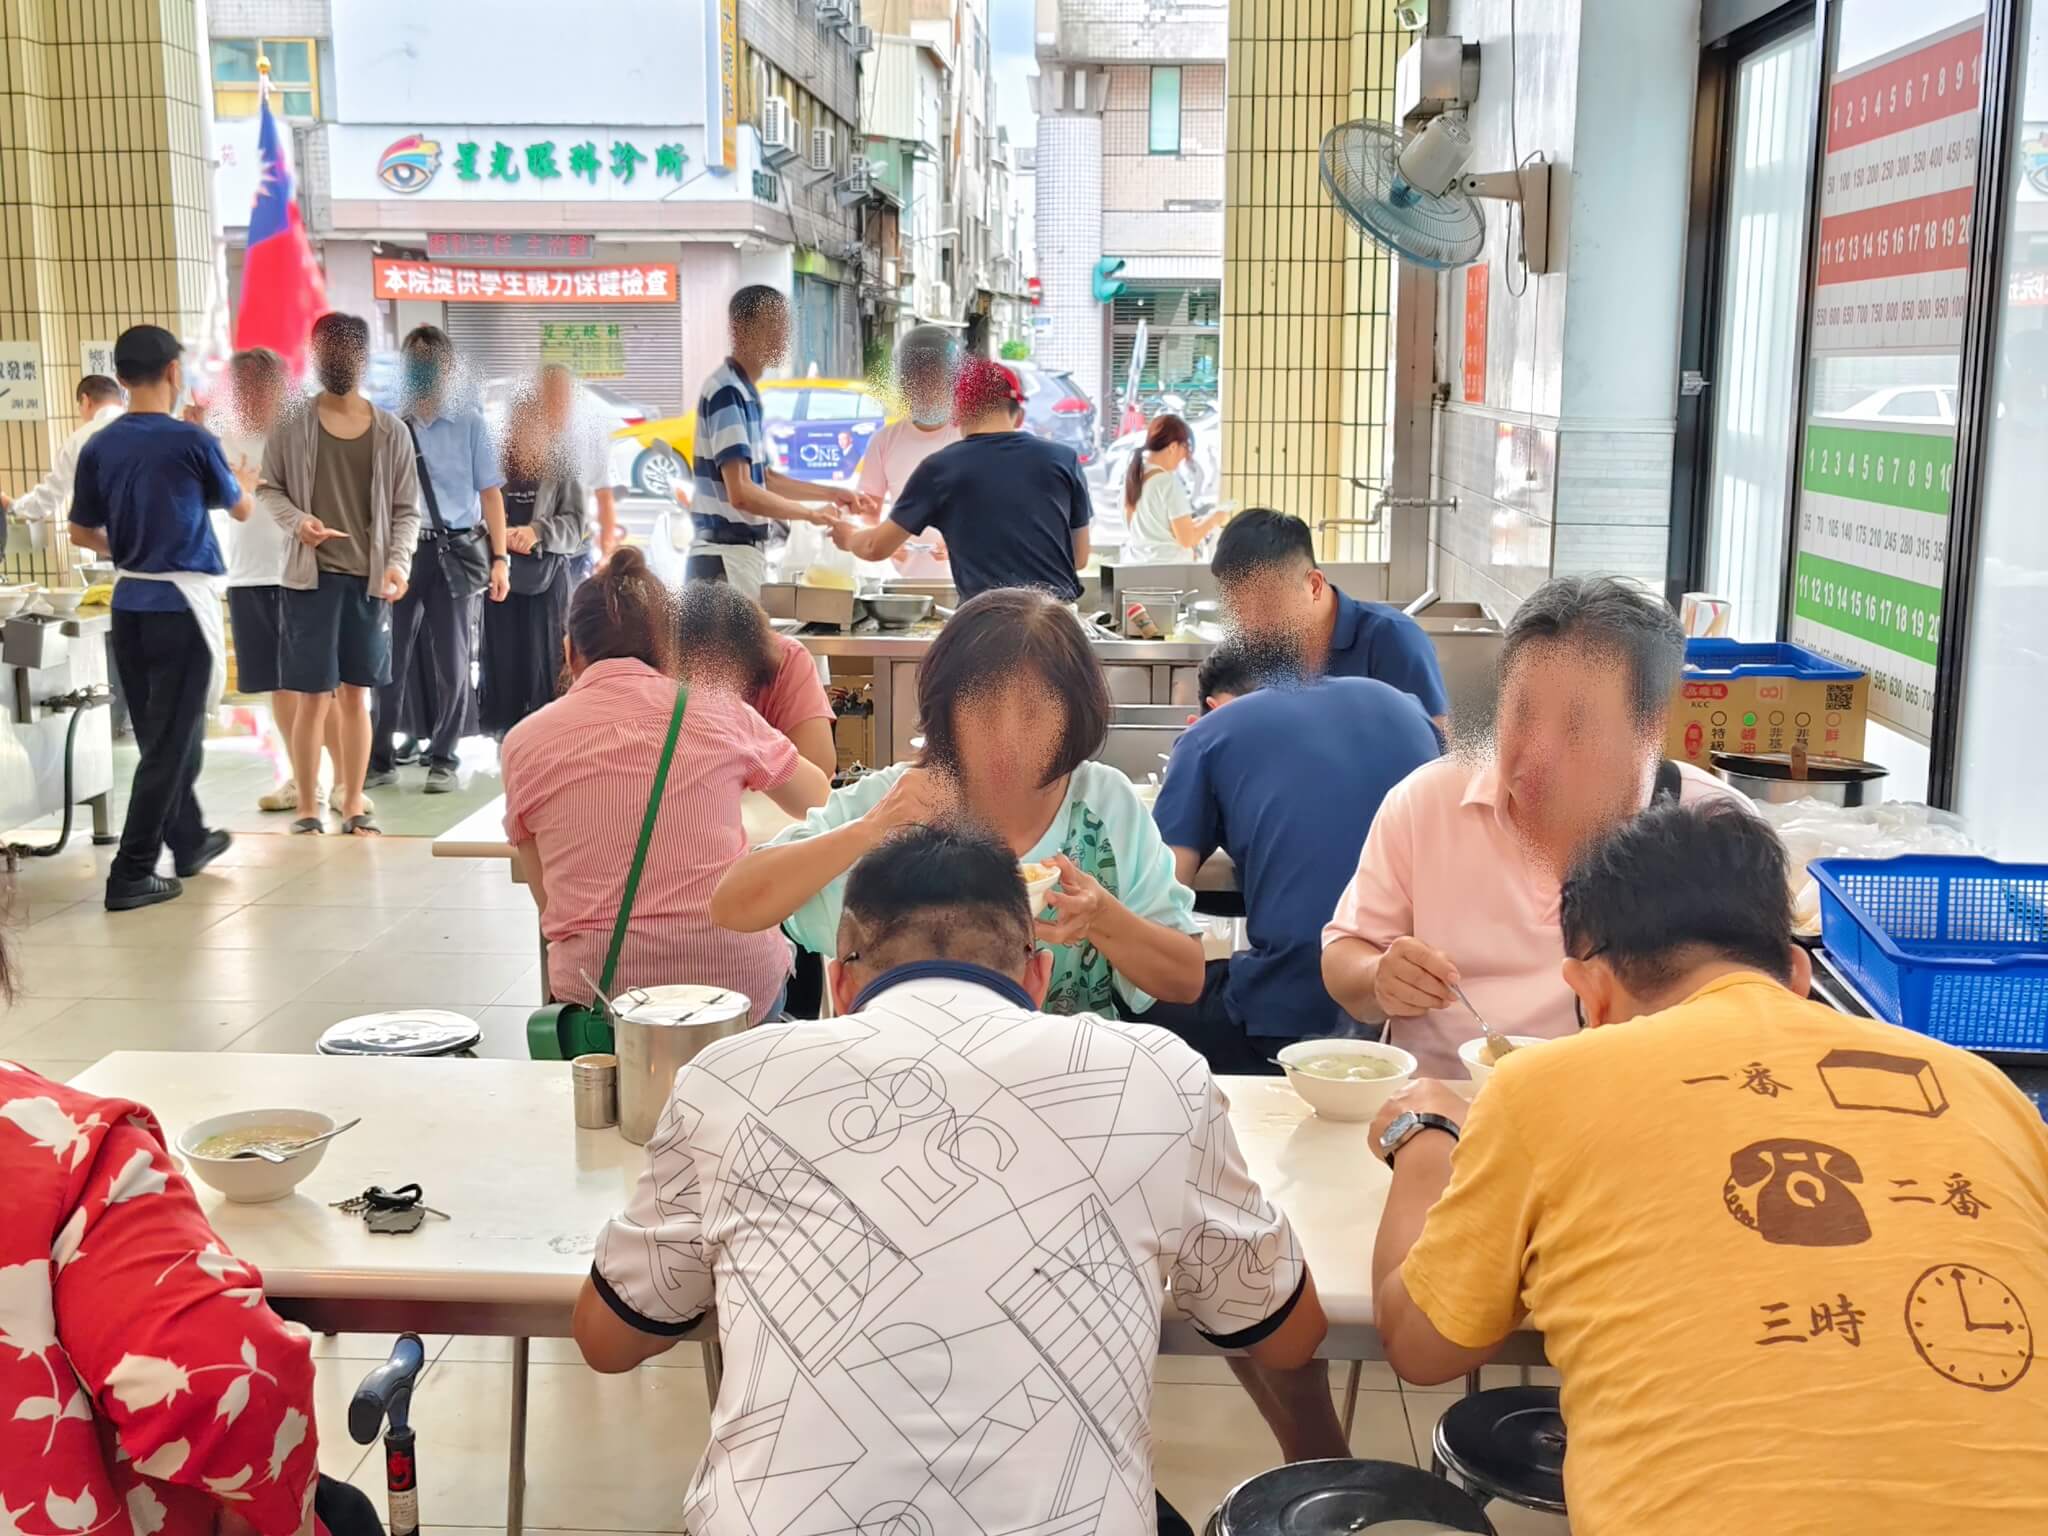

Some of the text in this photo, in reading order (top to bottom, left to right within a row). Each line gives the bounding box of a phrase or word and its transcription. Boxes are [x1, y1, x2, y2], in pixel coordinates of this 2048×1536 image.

[1834, 54, 1980, 132] 1 2 3 4 5 6 7 8 9 1
[454, 140, 690, 184] 星光眼科診所
[1853, 167, 1865, 187] 150
[1866, 163, 1879, 184] 200
[1881, 160, 1894, 181] 250
[1896, 156, 1910, 177] 300
[1912, 151, 1926, 173] 350
[1929, 146, 1943, 168] 400
[1946, 141, 1961, 163] 450
[1822, 240, 1831, 266] 11
[1834, 238, 1845, 263] 12
[1848, 235, 1859, 262] 13
[1862, 232, 1873, 259] 14
[1877, 229, 1888, 257] 15
[1892, 227, 1904, 255] 16
[1908, 223, 1921, 252] 17
[1924, 220, 1937, 249] 18
[1941, 217, 1954, 246] 19
[384, 266, 668, 298] 本院提供學生視力保健檢查
[1871, 303, 1883, 323] 750
[1901, 300, 1915, 321] 850
[1917, 299, 1931, 319] 900
[1934, 298, 1949, 318] 950
[800, 444, 841, 462] ONE
[1810, 448, 1815, 472] 1
[1821, 449, 1828, 473] 2
[1834, 451, 1841, 476] 3
[1848, 453, 1855, 478] 4
[1862, 454, 1870, 480] 5
[1877, 456, 1884, 482] 6
[1892, 458, 1900, 485] 7
[1908, 460, 1916, 488] 8
[1925, 462, 1933, 490] 9
[1828, 518, 1839, 538] 105
[1841, 521, 1852, 541] 140
[1855, 524, 1867, 545] 175
[1869, 528, 1882, 548] 210
[1883, 531, 1897, 552] 245
[1899, 534, 1913, 556] 280
[1916, 537, 1930, 561] 315
[1800, 575, 1808, 598] 11
[1811, 577, 1821, 603] 12
[1824, 582, 1833, 607] 13
[1837, 586, 1848, 611] 14
[1851, 590, 1862, 617] 15
[1865, 594, 1876, 622] 16
[1880, 599, 1892, 626] 17
[1895, 604, 1907, 632] 18
[1912, 609, 1924, 638] 19
[1889, 676, 1902, 698] 630
[1905, 683, 1919, 706] 665
[1682, 1062, 1793, 1098] 一番
[1888, 1173, 1992, 1219] 二番
[1755, 1294, 1866, 1347] 三時
